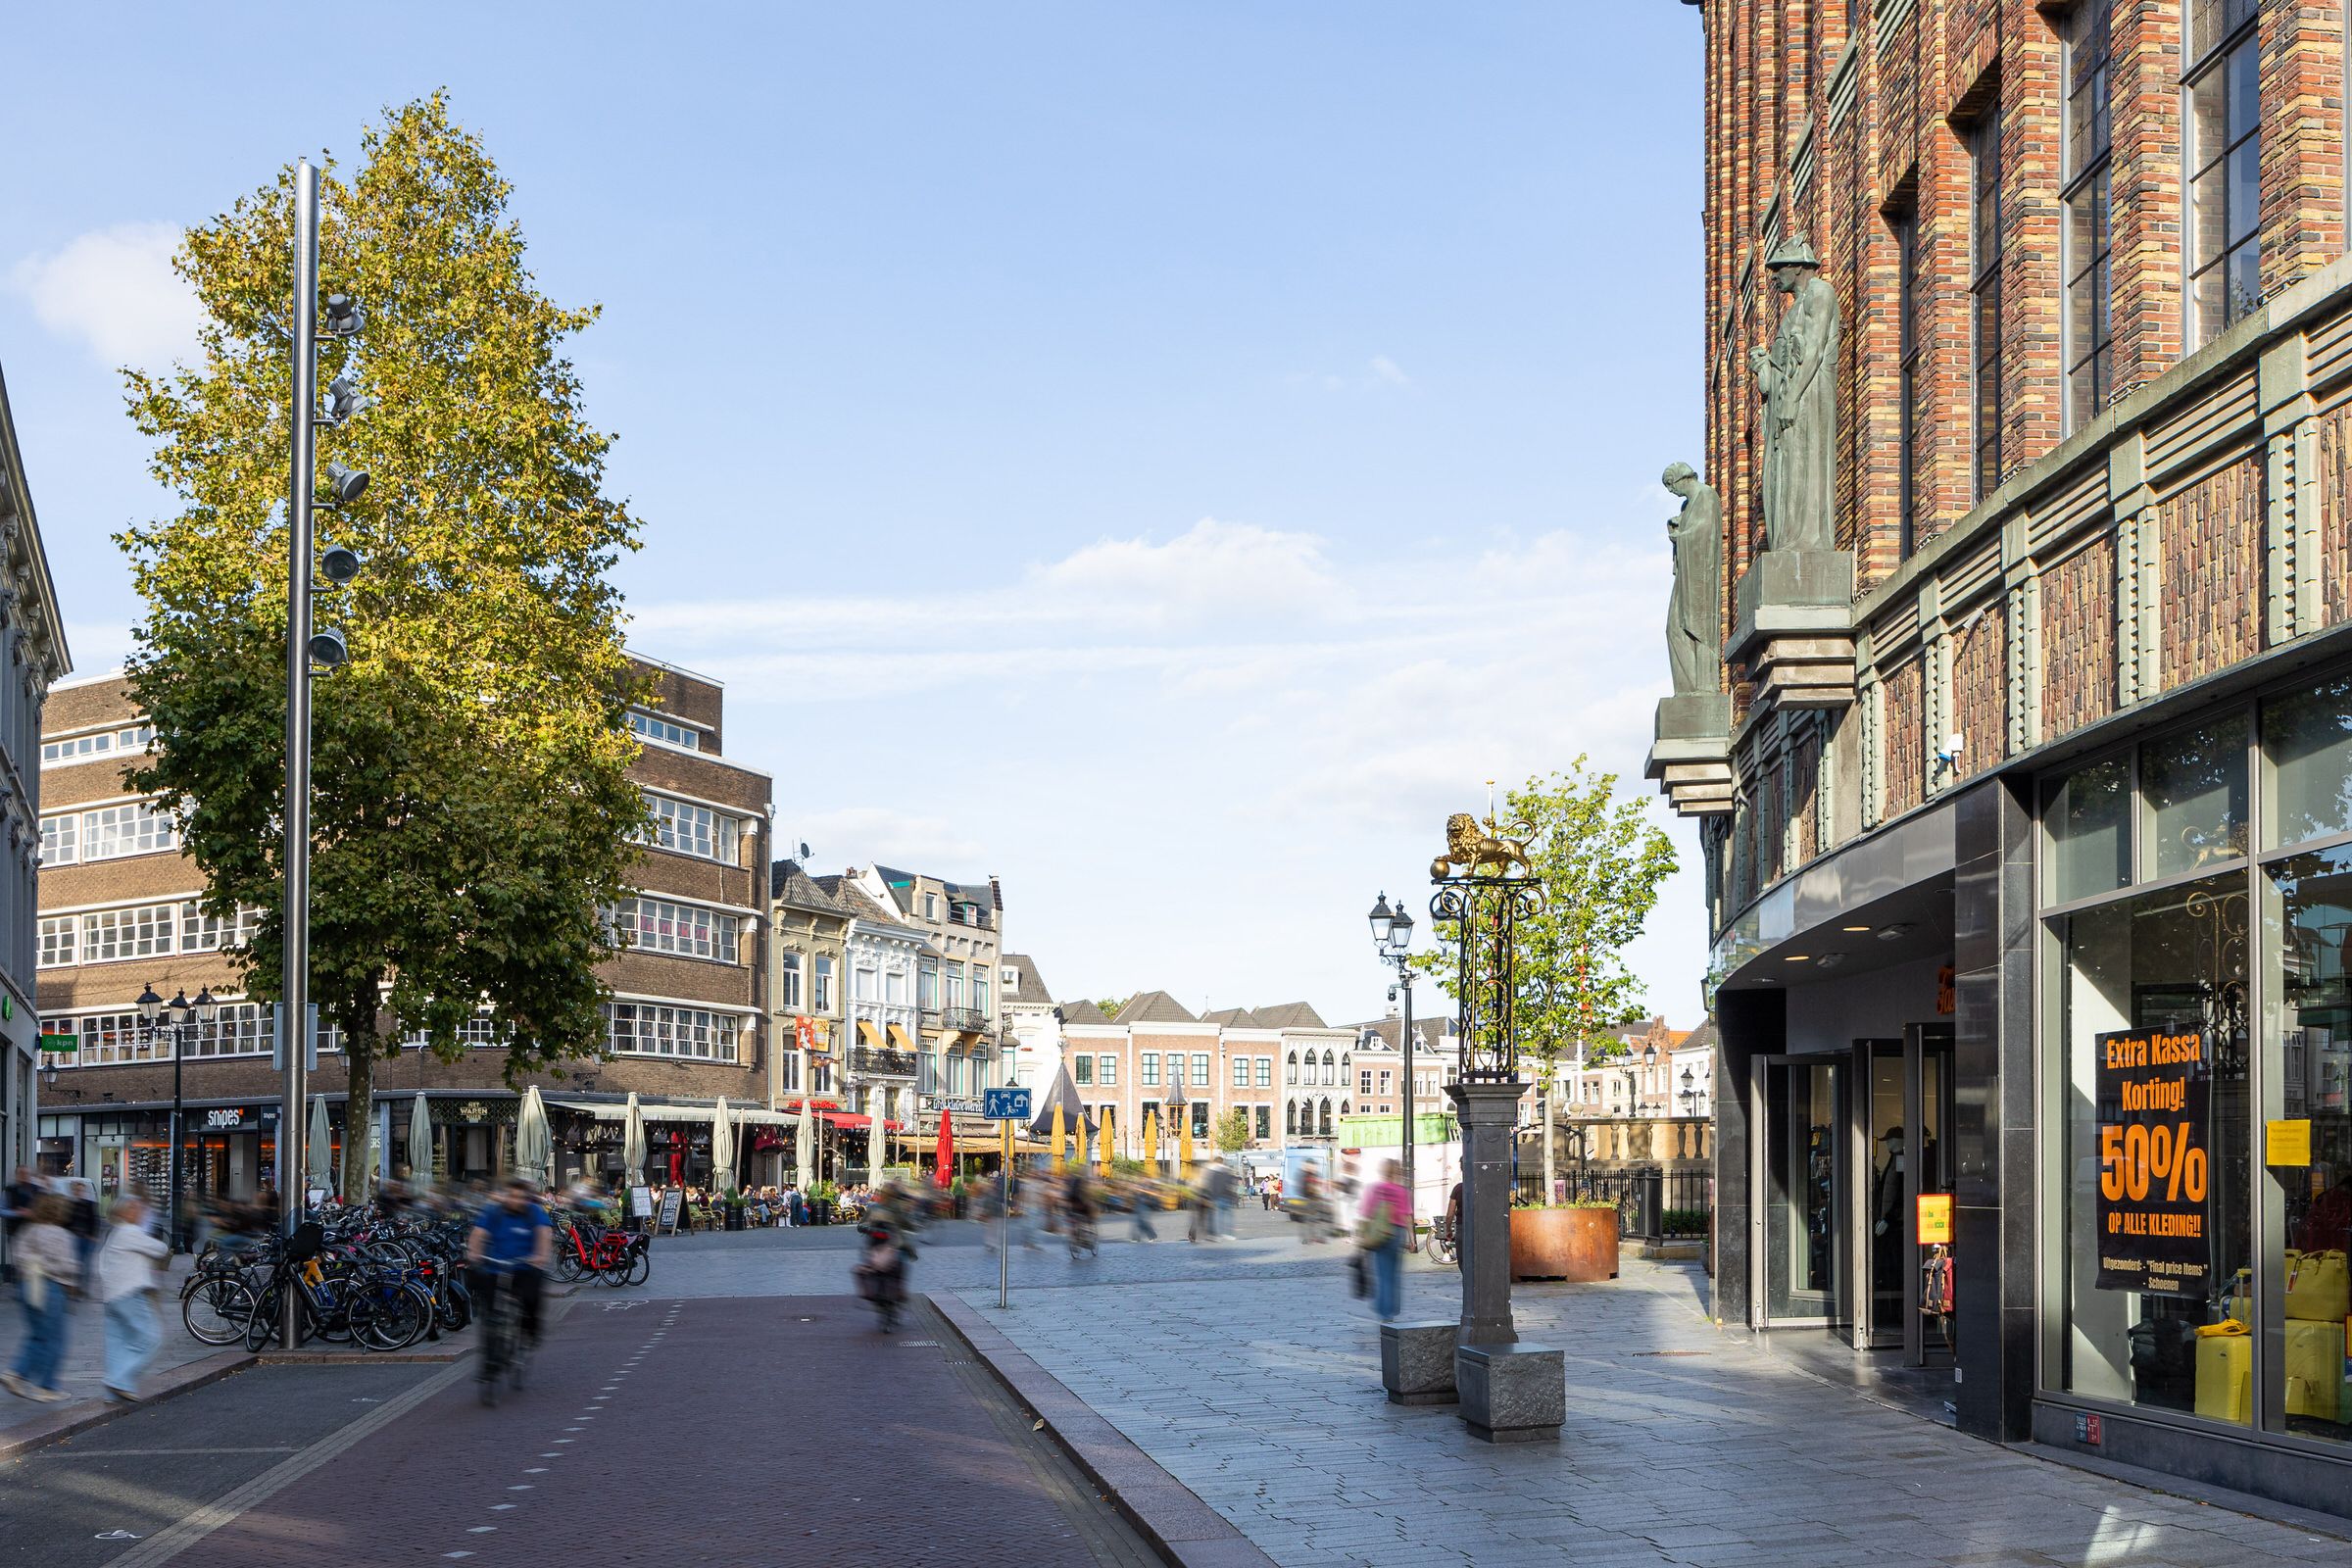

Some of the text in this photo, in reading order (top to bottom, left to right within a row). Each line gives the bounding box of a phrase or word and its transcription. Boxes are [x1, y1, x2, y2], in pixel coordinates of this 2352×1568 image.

[2107, 1034, 2200, 1069] Extra Kassa
[2122, 1076, 2185, 1111] Korting!
[208, 1109, 240, 1128] snipes
[2101, 1122, 2208, 1202] 50%
[2108, 1212, 2201, 1238] OP ALLE KLEDING!!
[2165, 1262, 2182, 1276] price
[2148, 1276, 2180, 1292] Schoenen
